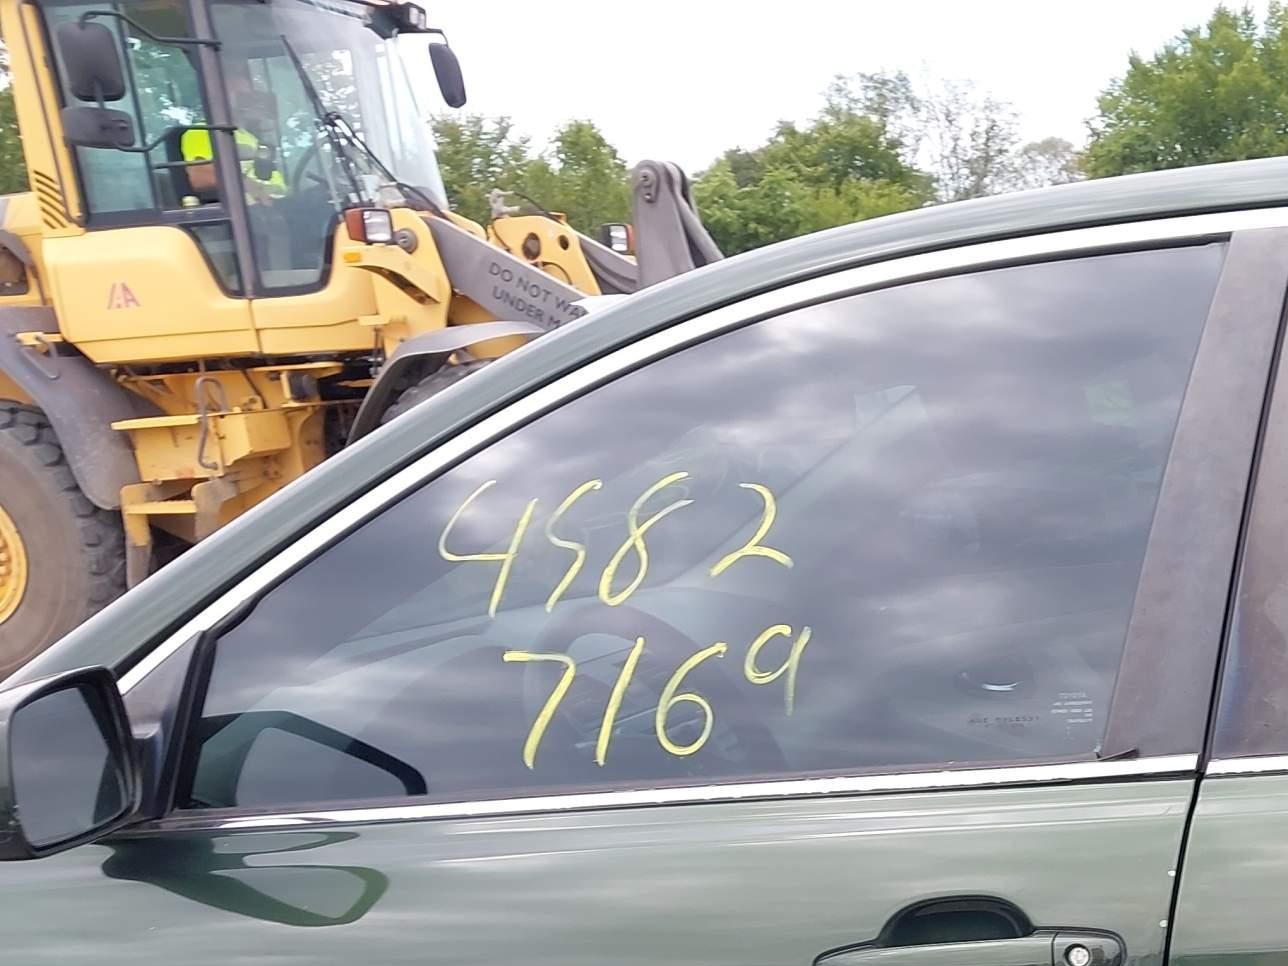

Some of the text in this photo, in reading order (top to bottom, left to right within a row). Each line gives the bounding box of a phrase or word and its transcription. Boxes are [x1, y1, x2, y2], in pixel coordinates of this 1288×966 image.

[488, 262, 514, 282] DO
[515, 277, 552, 302] NOT
[492, 286, 545, 322] UNDER
[439, 471, 795, 620] 4582
[503, 624, 812, 769] 7169
